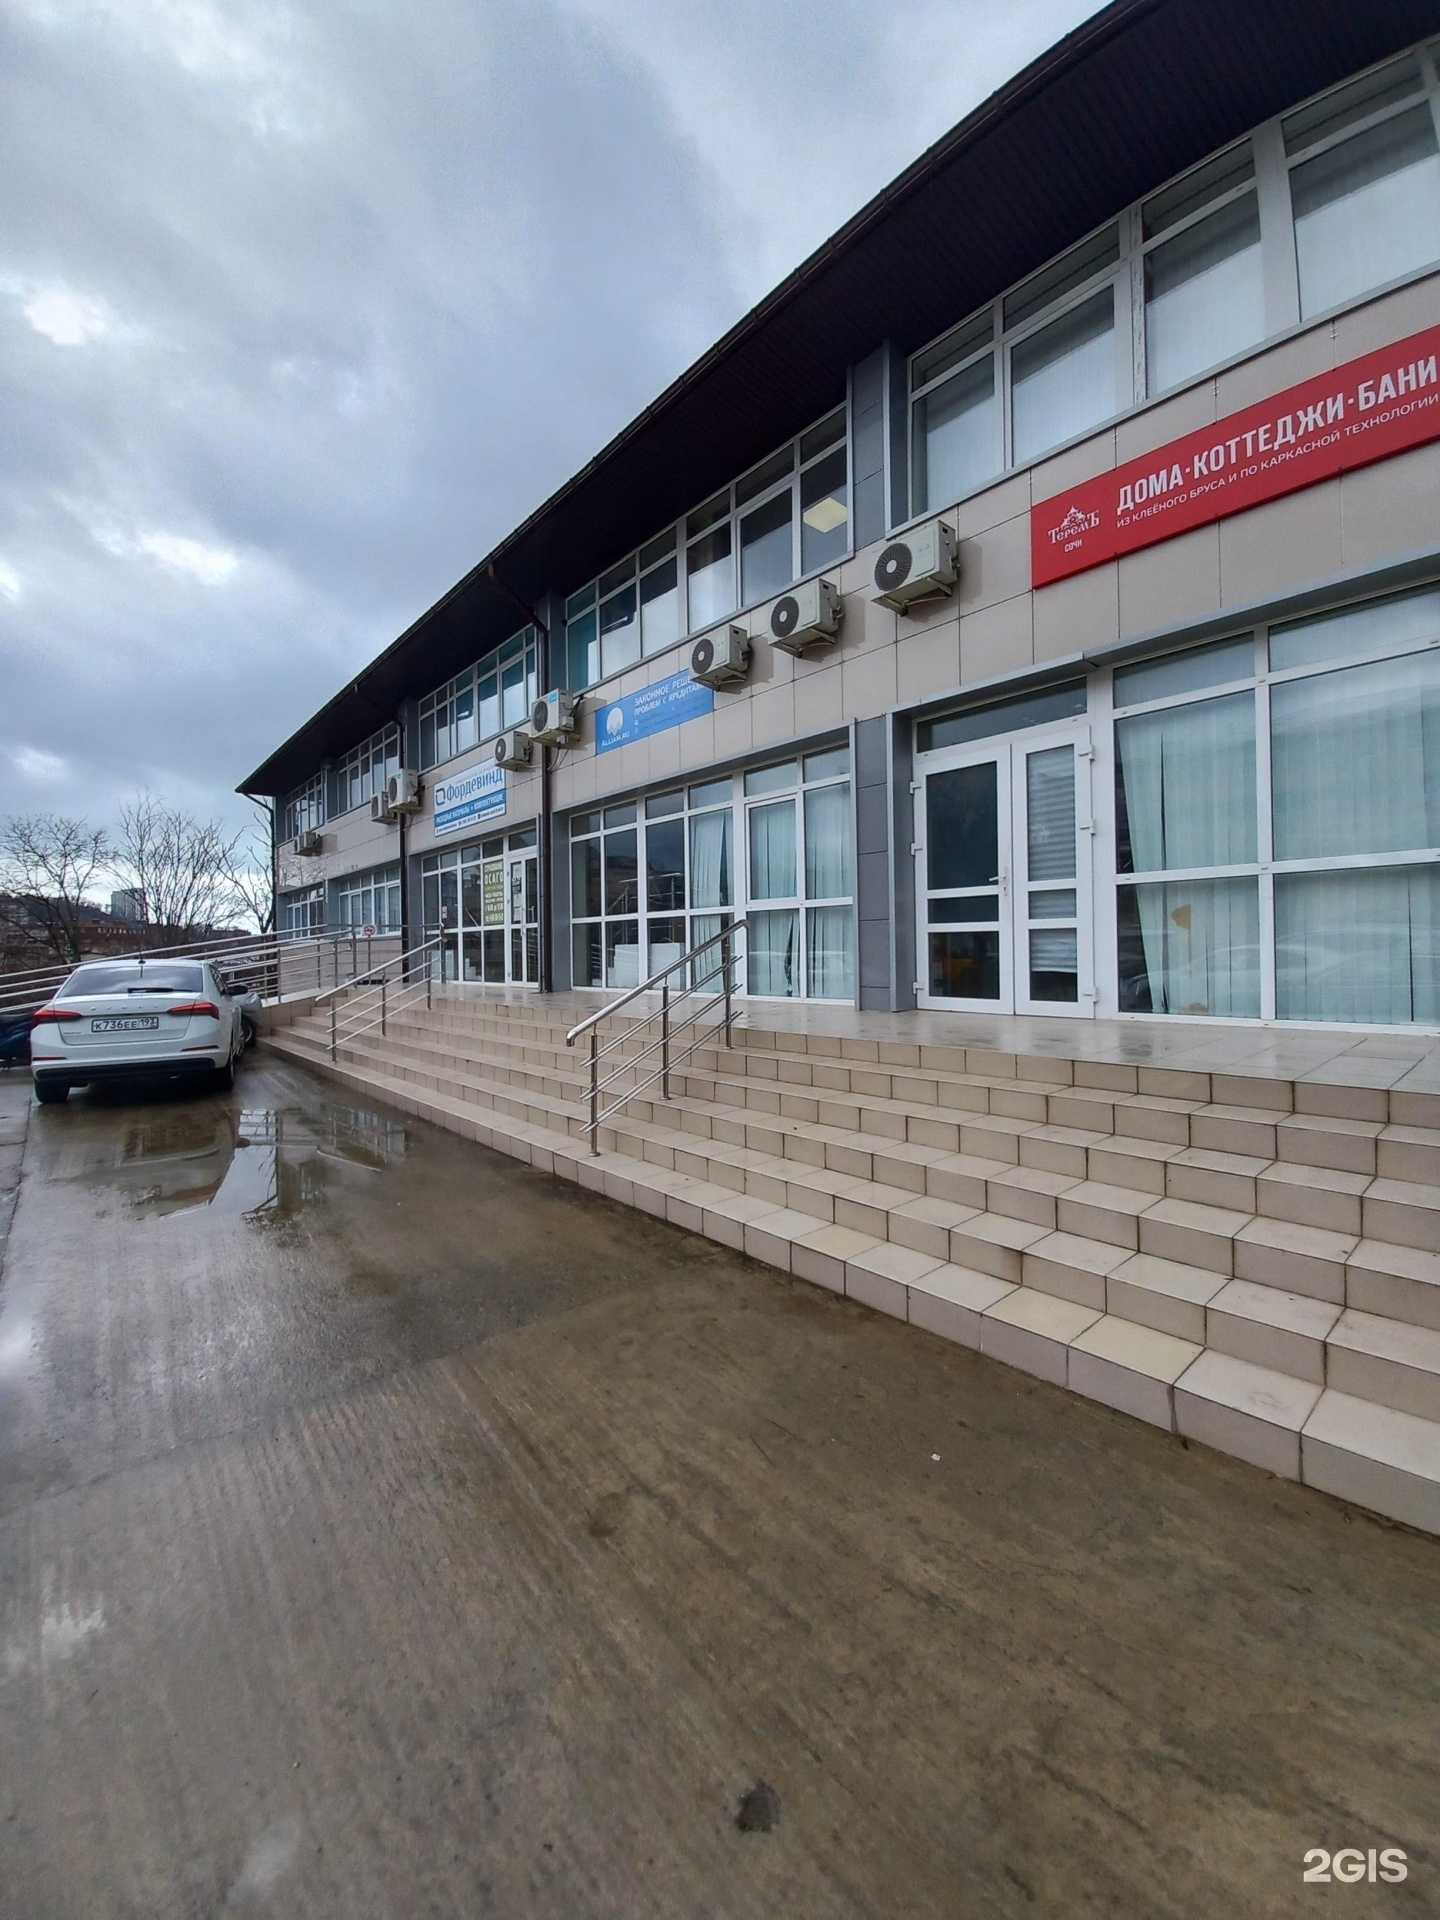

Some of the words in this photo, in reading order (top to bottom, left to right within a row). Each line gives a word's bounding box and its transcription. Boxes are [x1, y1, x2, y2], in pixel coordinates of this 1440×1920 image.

[1116, 463, 1184, 516] ДОМА
[1193, 392, 1345, 479] КОТТЕДЖИ
[1357, 355, 1438, 412] БАНИ
[1116, 516, 1130, 529] ИЗ
[1189, 477, 1227, 498] БРУСА
[1228, 470, 1238, 484] И
[1240, 465, 1258, 479] ПО
[1260, 430, 1341, 470] КАРКАСНОЙ
[1343, 392, 1439, 437] ТЕХНОЛОГИИ
[446, 768, 503, 801] Фордевинд
